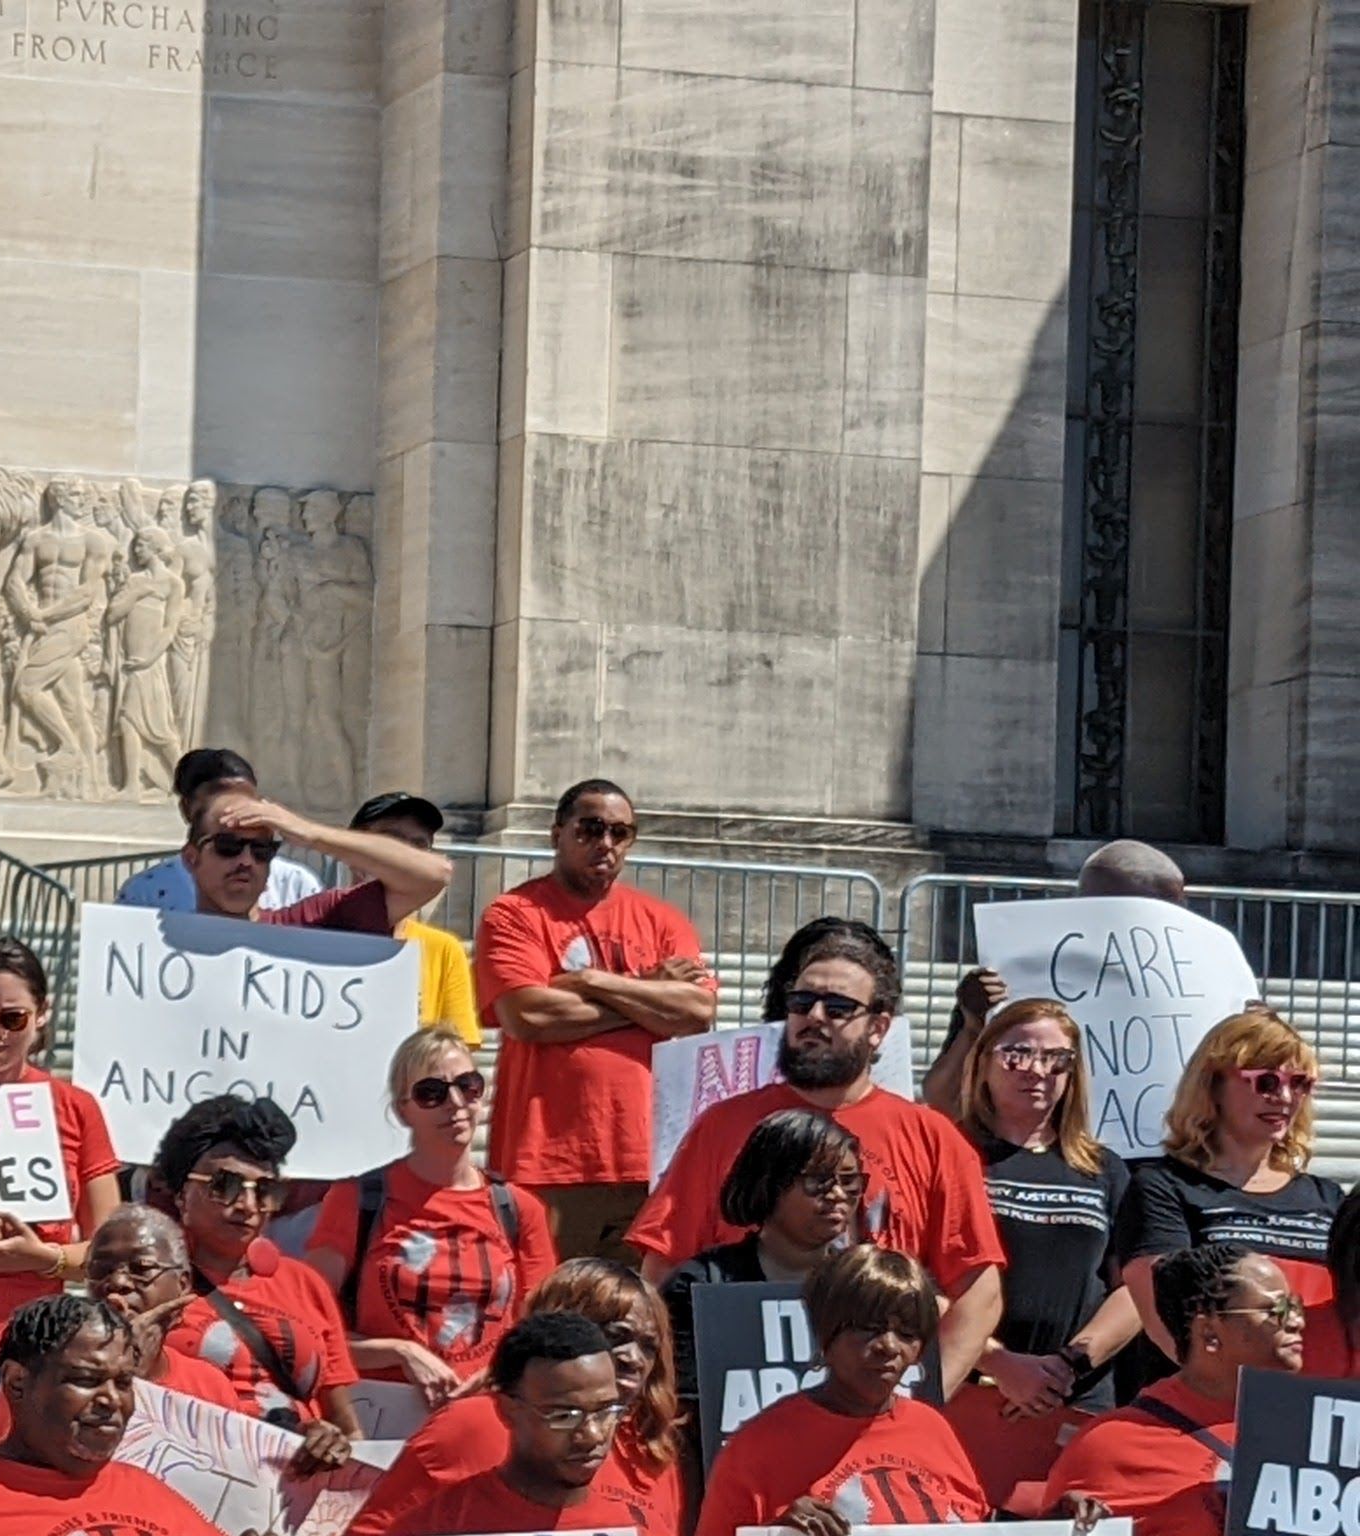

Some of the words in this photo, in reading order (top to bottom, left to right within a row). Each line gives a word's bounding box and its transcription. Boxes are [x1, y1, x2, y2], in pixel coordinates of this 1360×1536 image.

[12, 33, 107, 66] FROM
[148, 44, 278, 80] FRANCE
[105, 940, 194, 1001] NO
[241, 956, 364, 1030] KIDS
[1050, 925, 1206, 1002] CARE
[200, 1027, 249, 1061] IN
